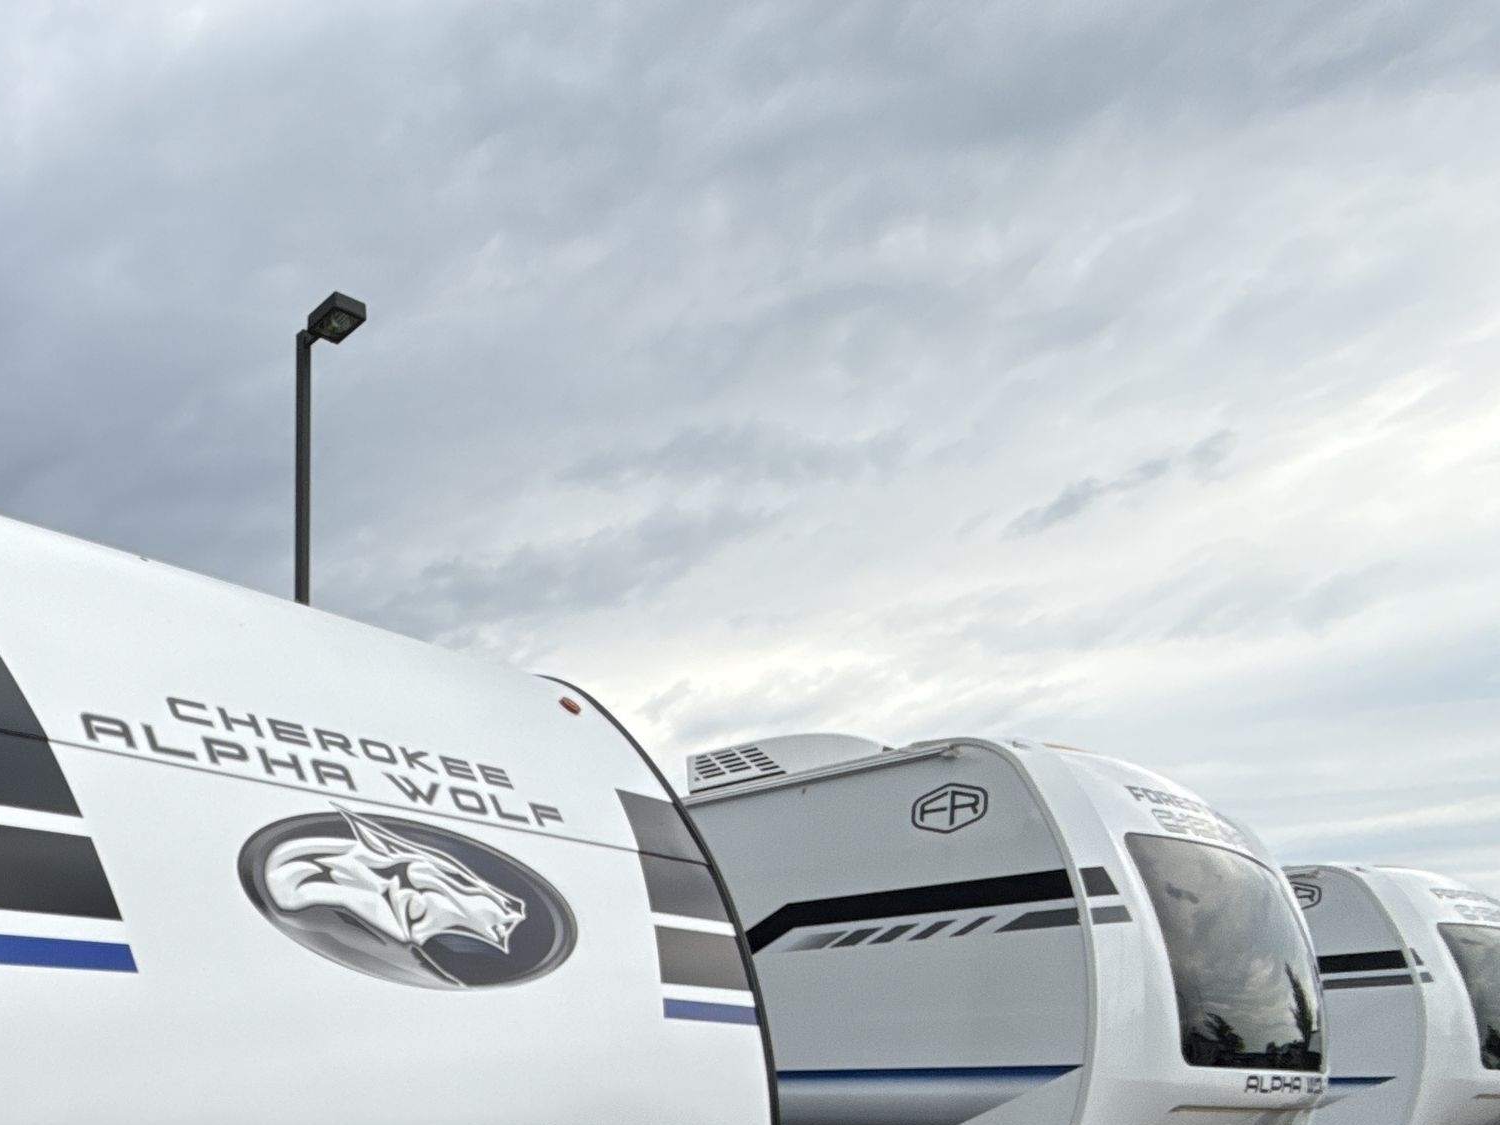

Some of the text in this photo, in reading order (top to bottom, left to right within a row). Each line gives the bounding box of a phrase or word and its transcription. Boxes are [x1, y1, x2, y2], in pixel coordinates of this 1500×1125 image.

[79, 711, 565, 827] ALPHA WOLF
[165, 696, 515, 790] CHEROKEE
[919, 789, 980, 826] FR
[1244, 1075, 1301, 1094] ALPHA
